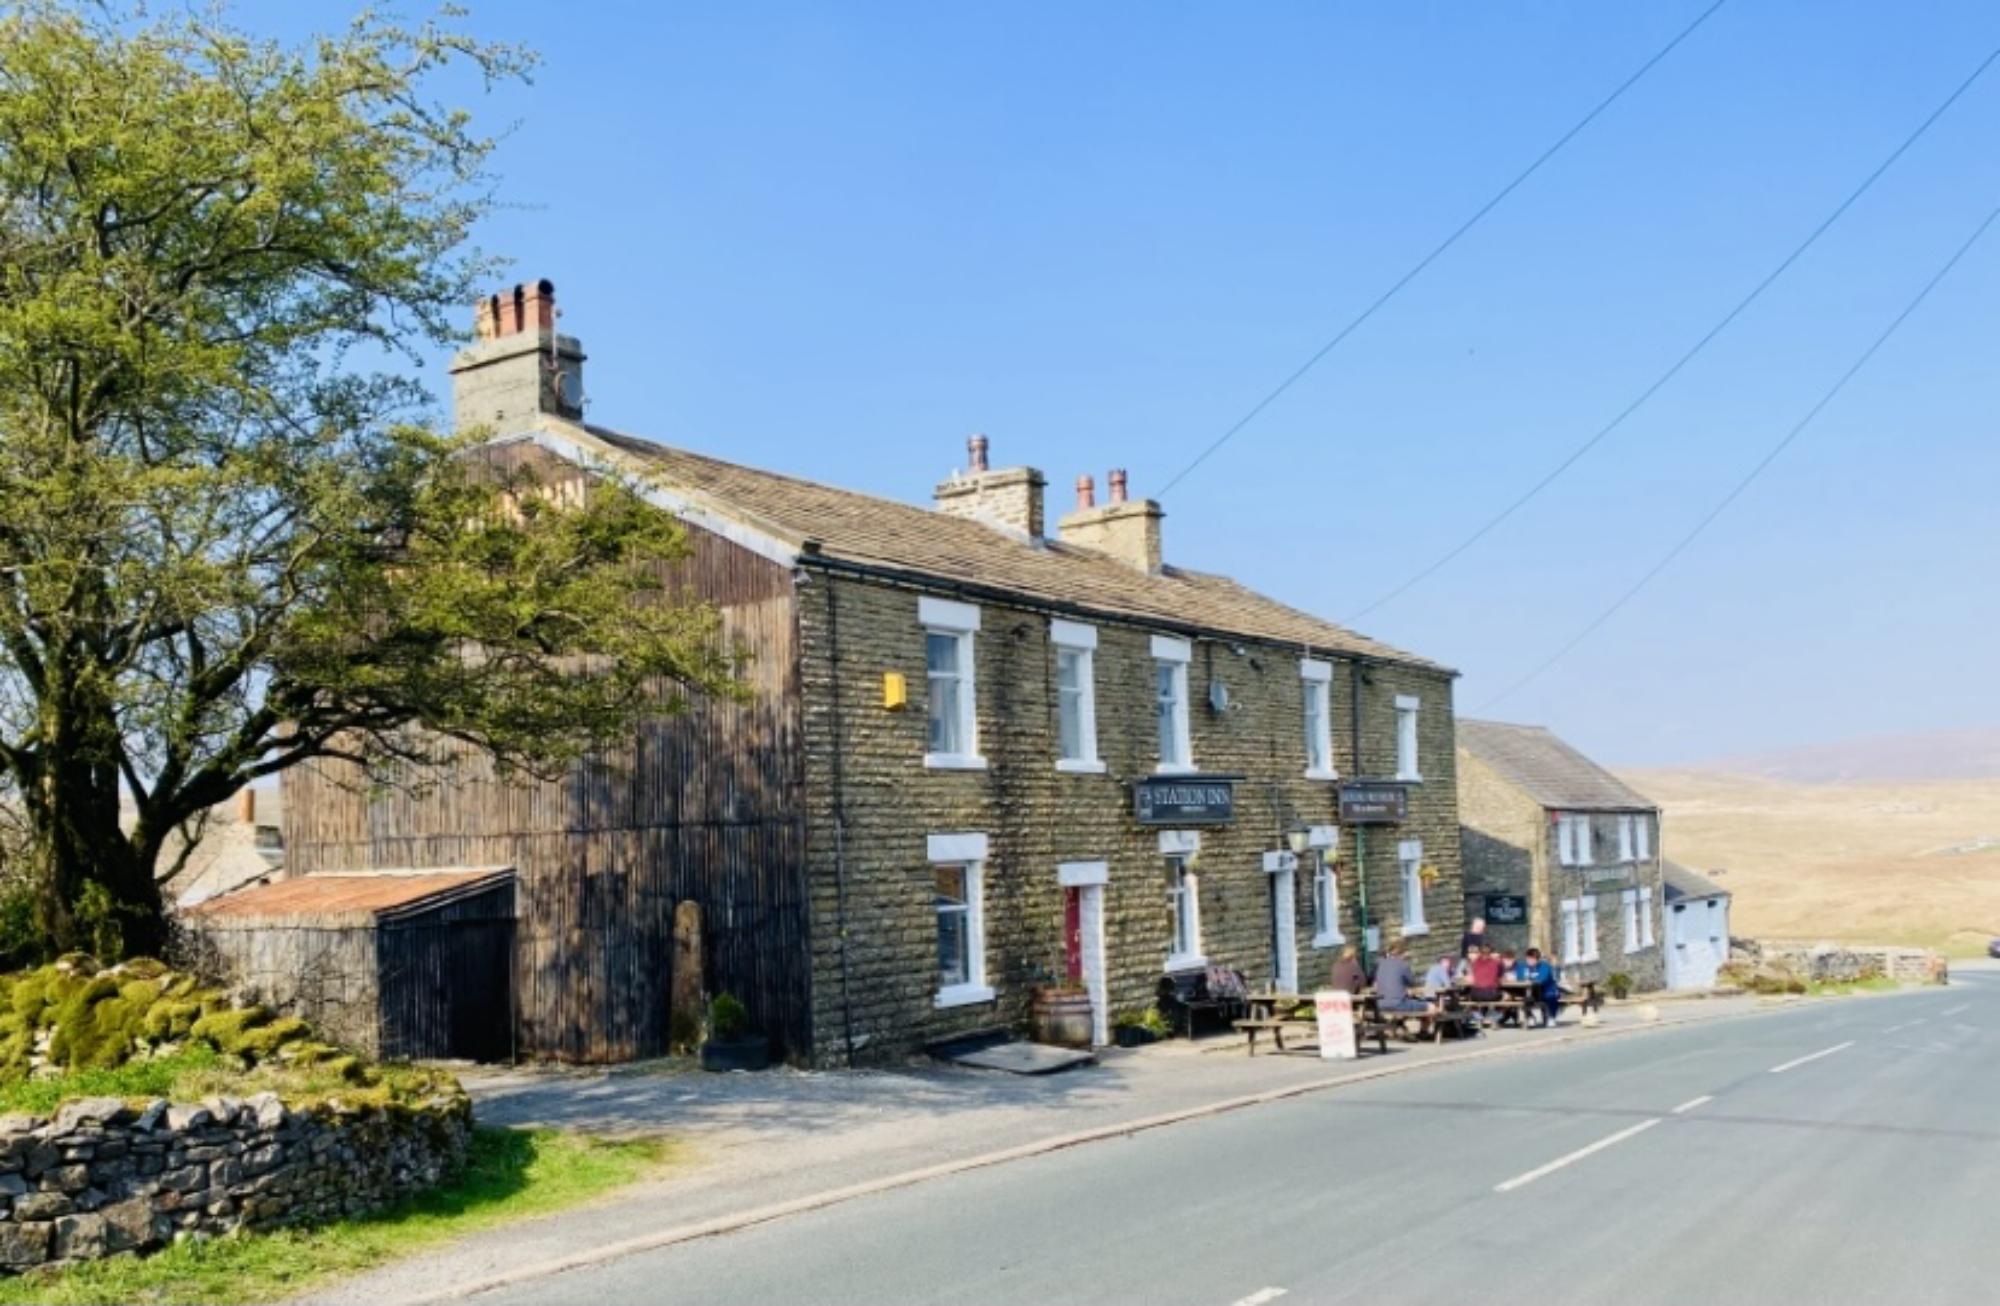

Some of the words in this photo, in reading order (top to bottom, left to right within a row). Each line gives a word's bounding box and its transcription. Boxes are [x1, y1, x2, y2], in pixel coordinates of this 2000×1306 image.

[1154, 786, 1206, 805] STATION
[1207, 787, 1231, 805] INN
[1319, 1000, 1350, 1013] OPEN
